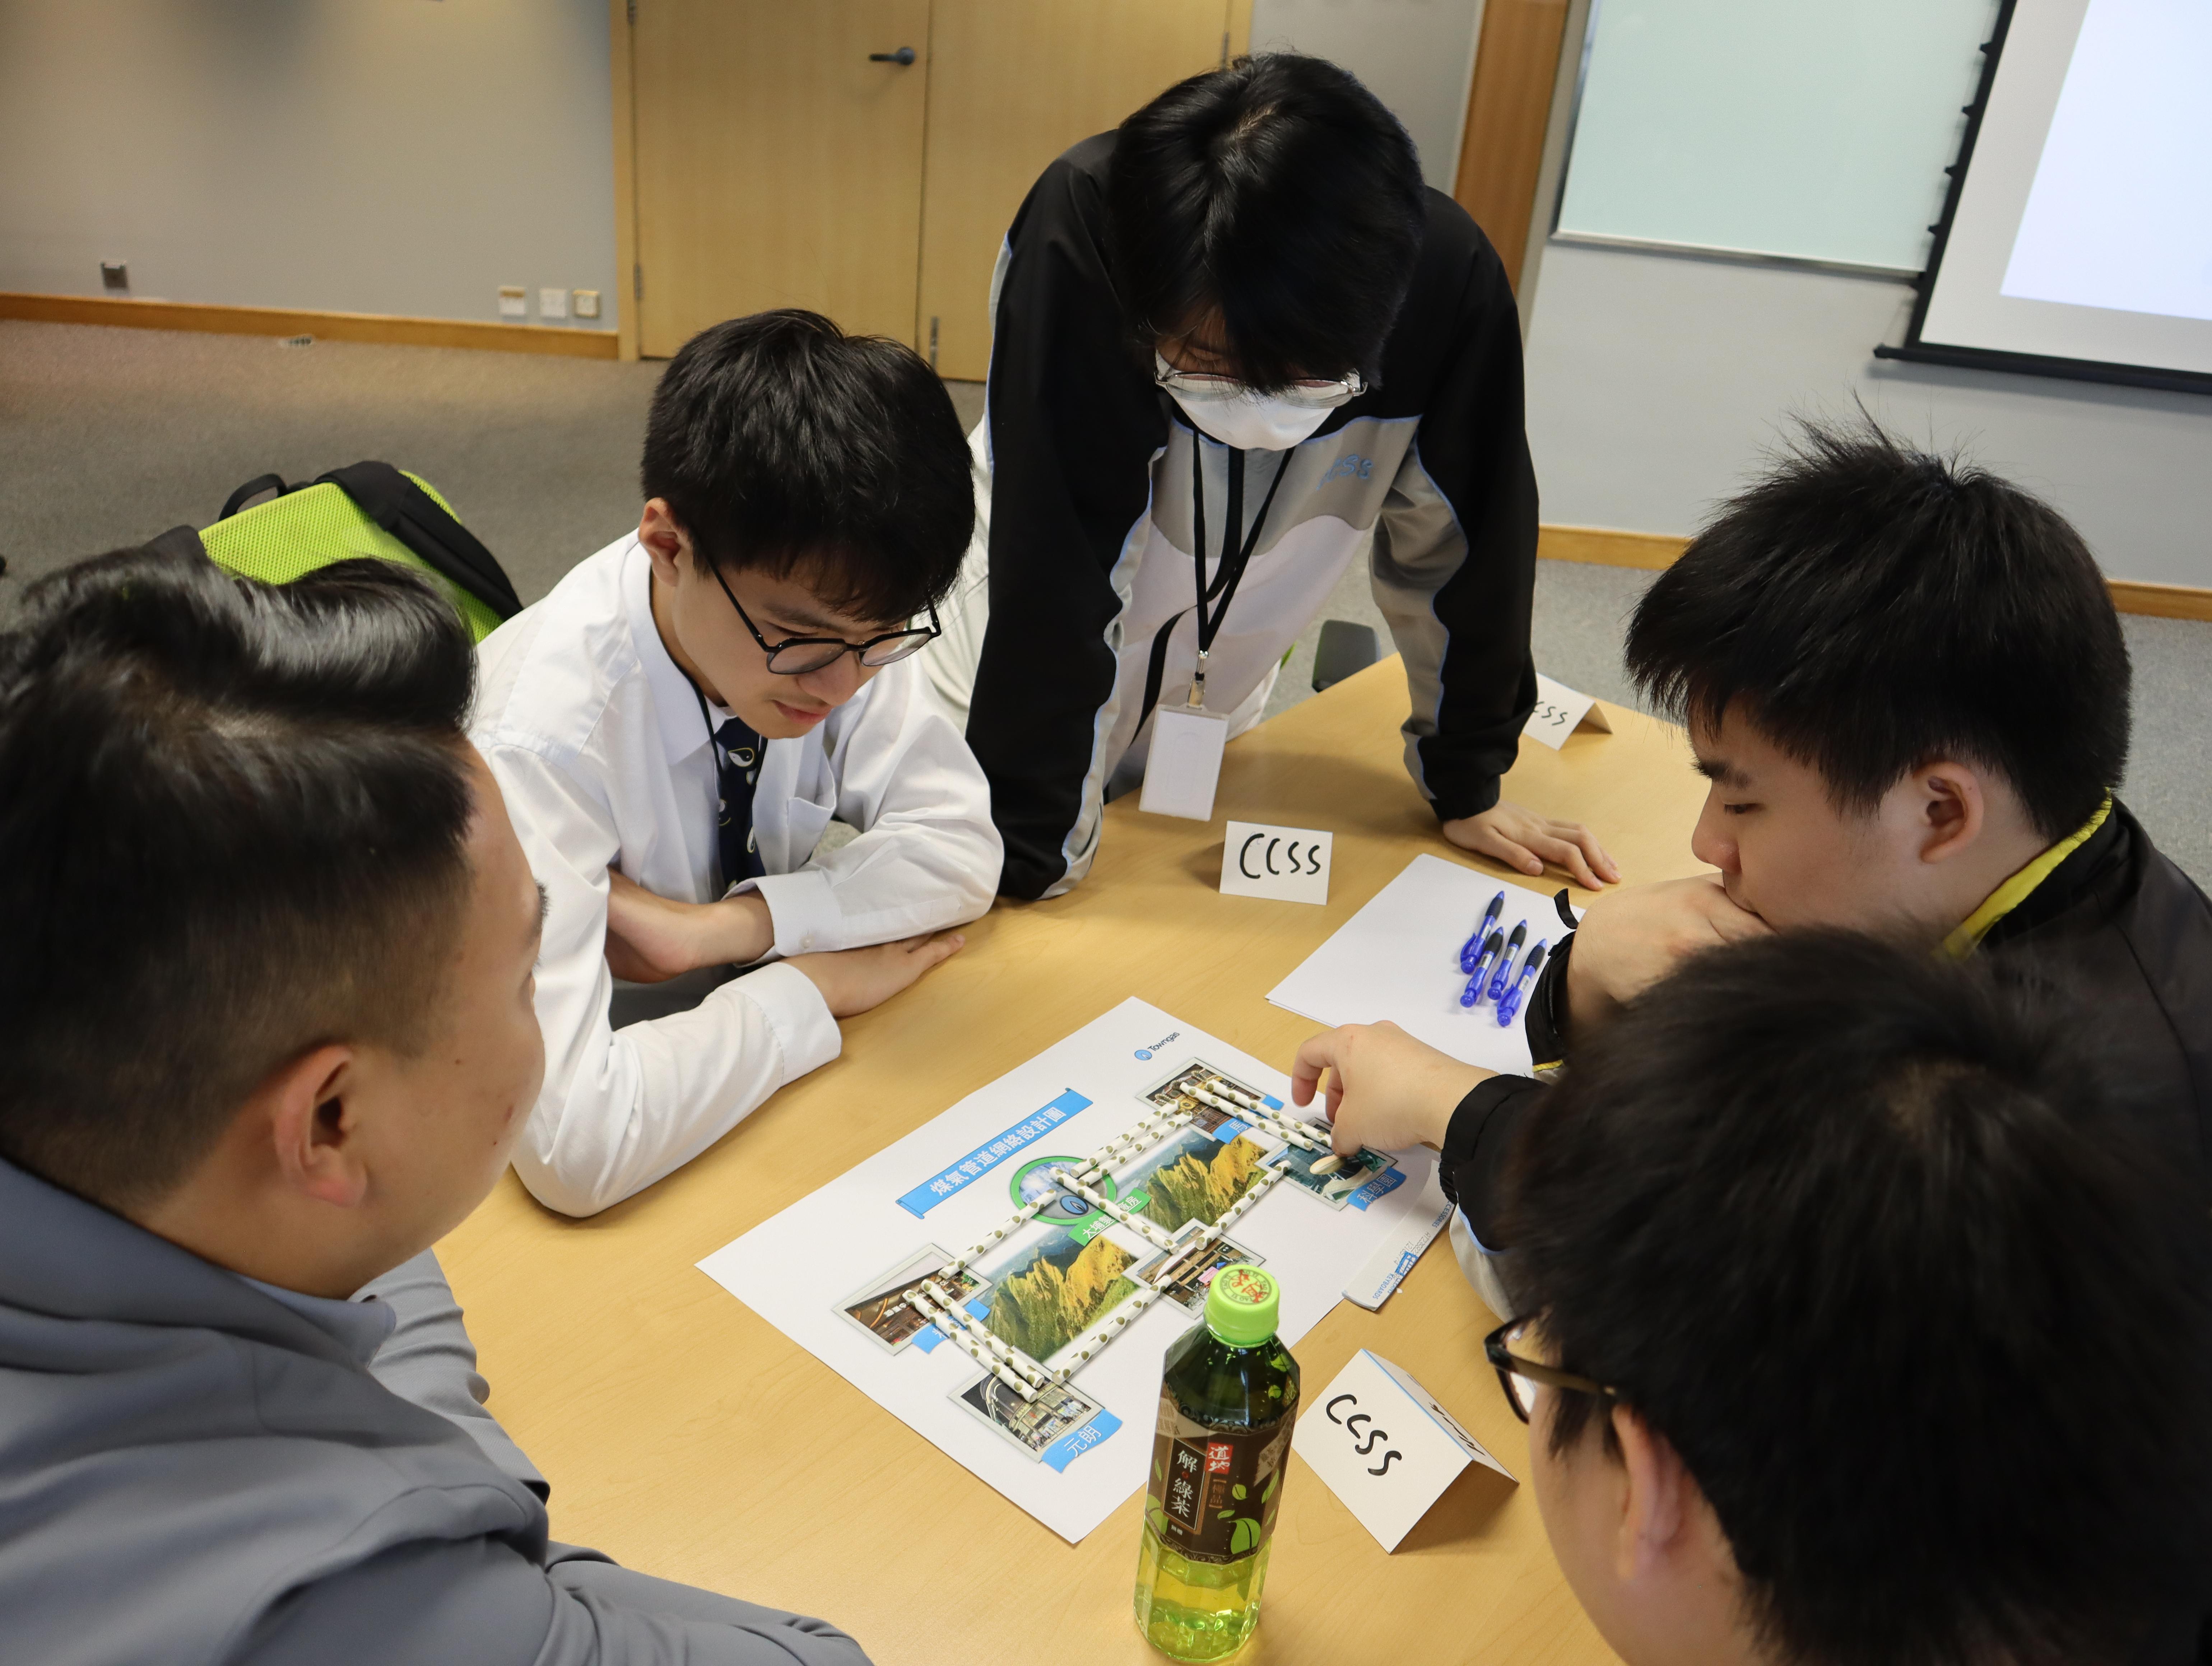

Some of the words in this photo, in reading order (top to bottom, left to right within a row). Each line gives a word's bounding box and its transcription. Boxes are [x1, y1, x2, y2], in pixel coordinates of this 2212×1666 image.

[1533, 701, 1568, 726] CSS
[1240, 833, 1320, 879] CCSS
[1147, 1032, 1180, 1051] Towngas
[930, 1106, 1067, 1196] 煤氣管道網絡設計圖
[1357, 1173, 1397, 1203] 科學園
[1083, 1196, 1139, 1238] 大埔製廠房
[1372, 1273, 1394, 1299] KEYBOARDS
[1064, 1425, 1102, 1457] 元朗
[1326, 1394, 1402, 1476] CCSS
[1208, 1446, 1230, 1471] 道地
